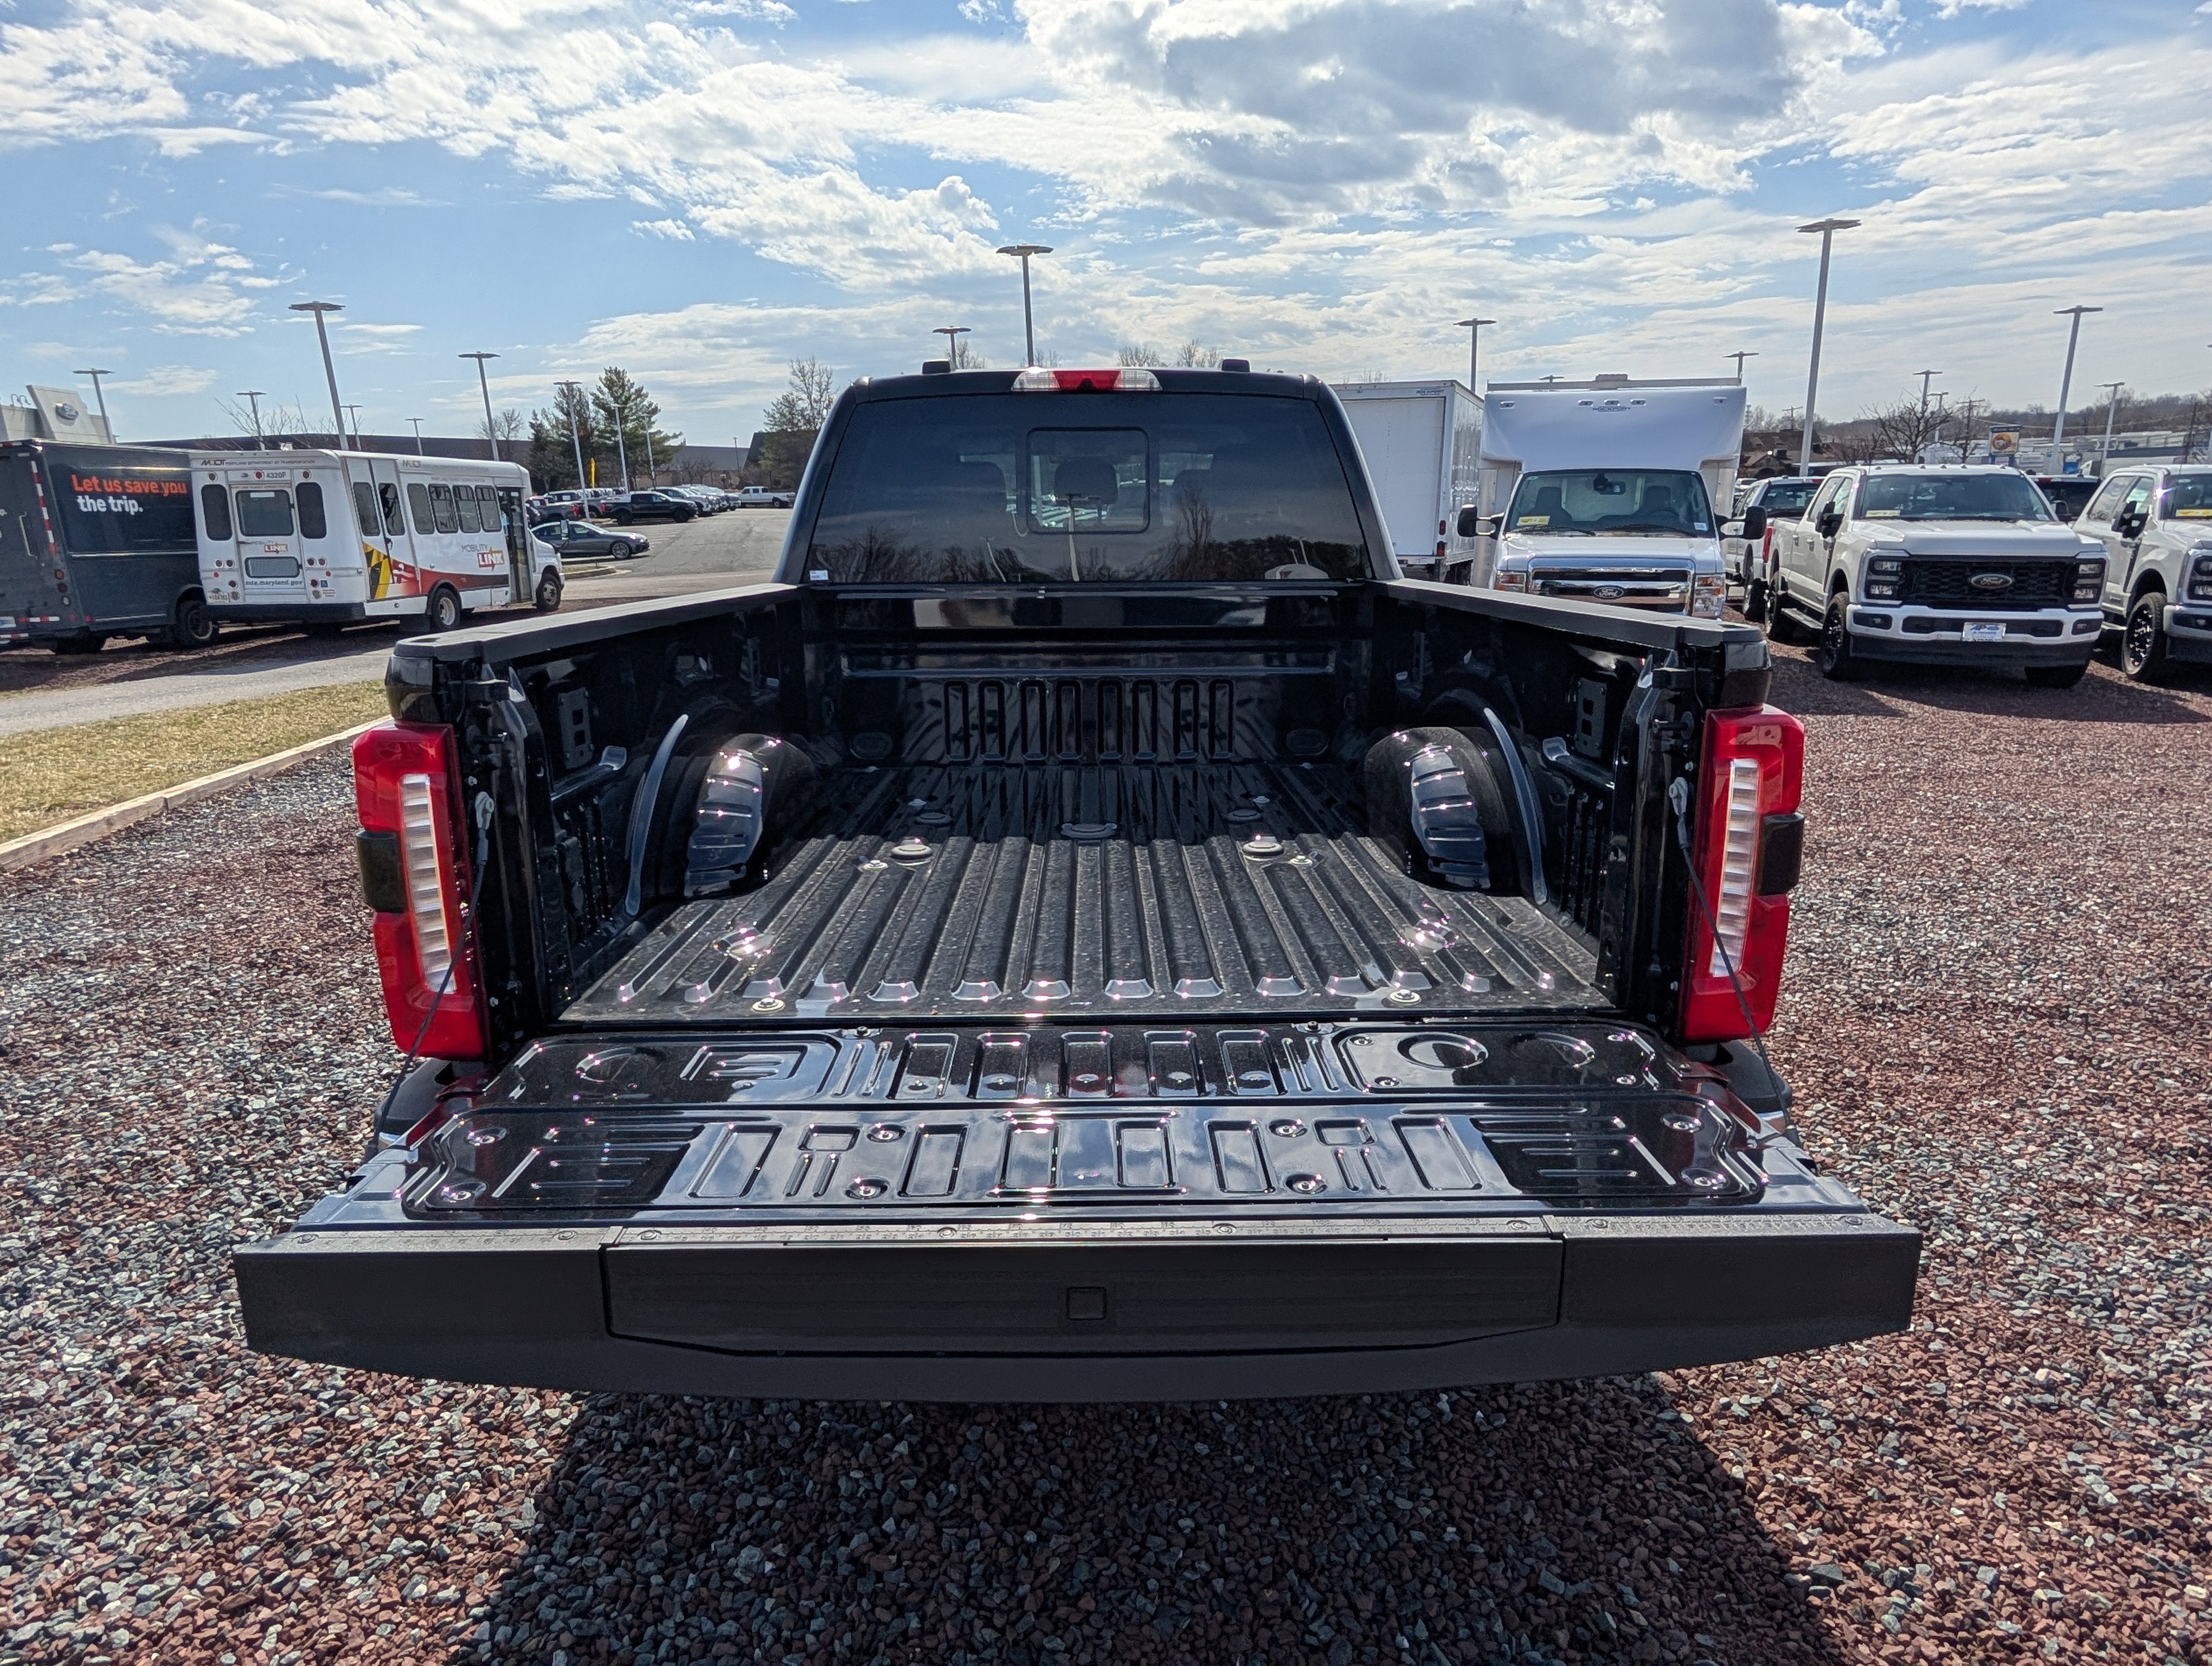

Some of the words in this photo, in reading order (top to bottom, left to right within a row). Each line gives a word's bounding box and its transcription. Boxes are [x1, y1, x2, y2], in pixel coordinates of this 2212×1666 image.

[71, 474, 102, 492] Let
[103, 478, 123, 493] us
[124, 480, 159, 494] save
[160, 482, 188, 497] you
[77, 495, 107, 512] the
[108, 495, 144, 515] trip.
[461, 543, 488, 553] MOBILITY
[478, 553, 504, 565] LINK
